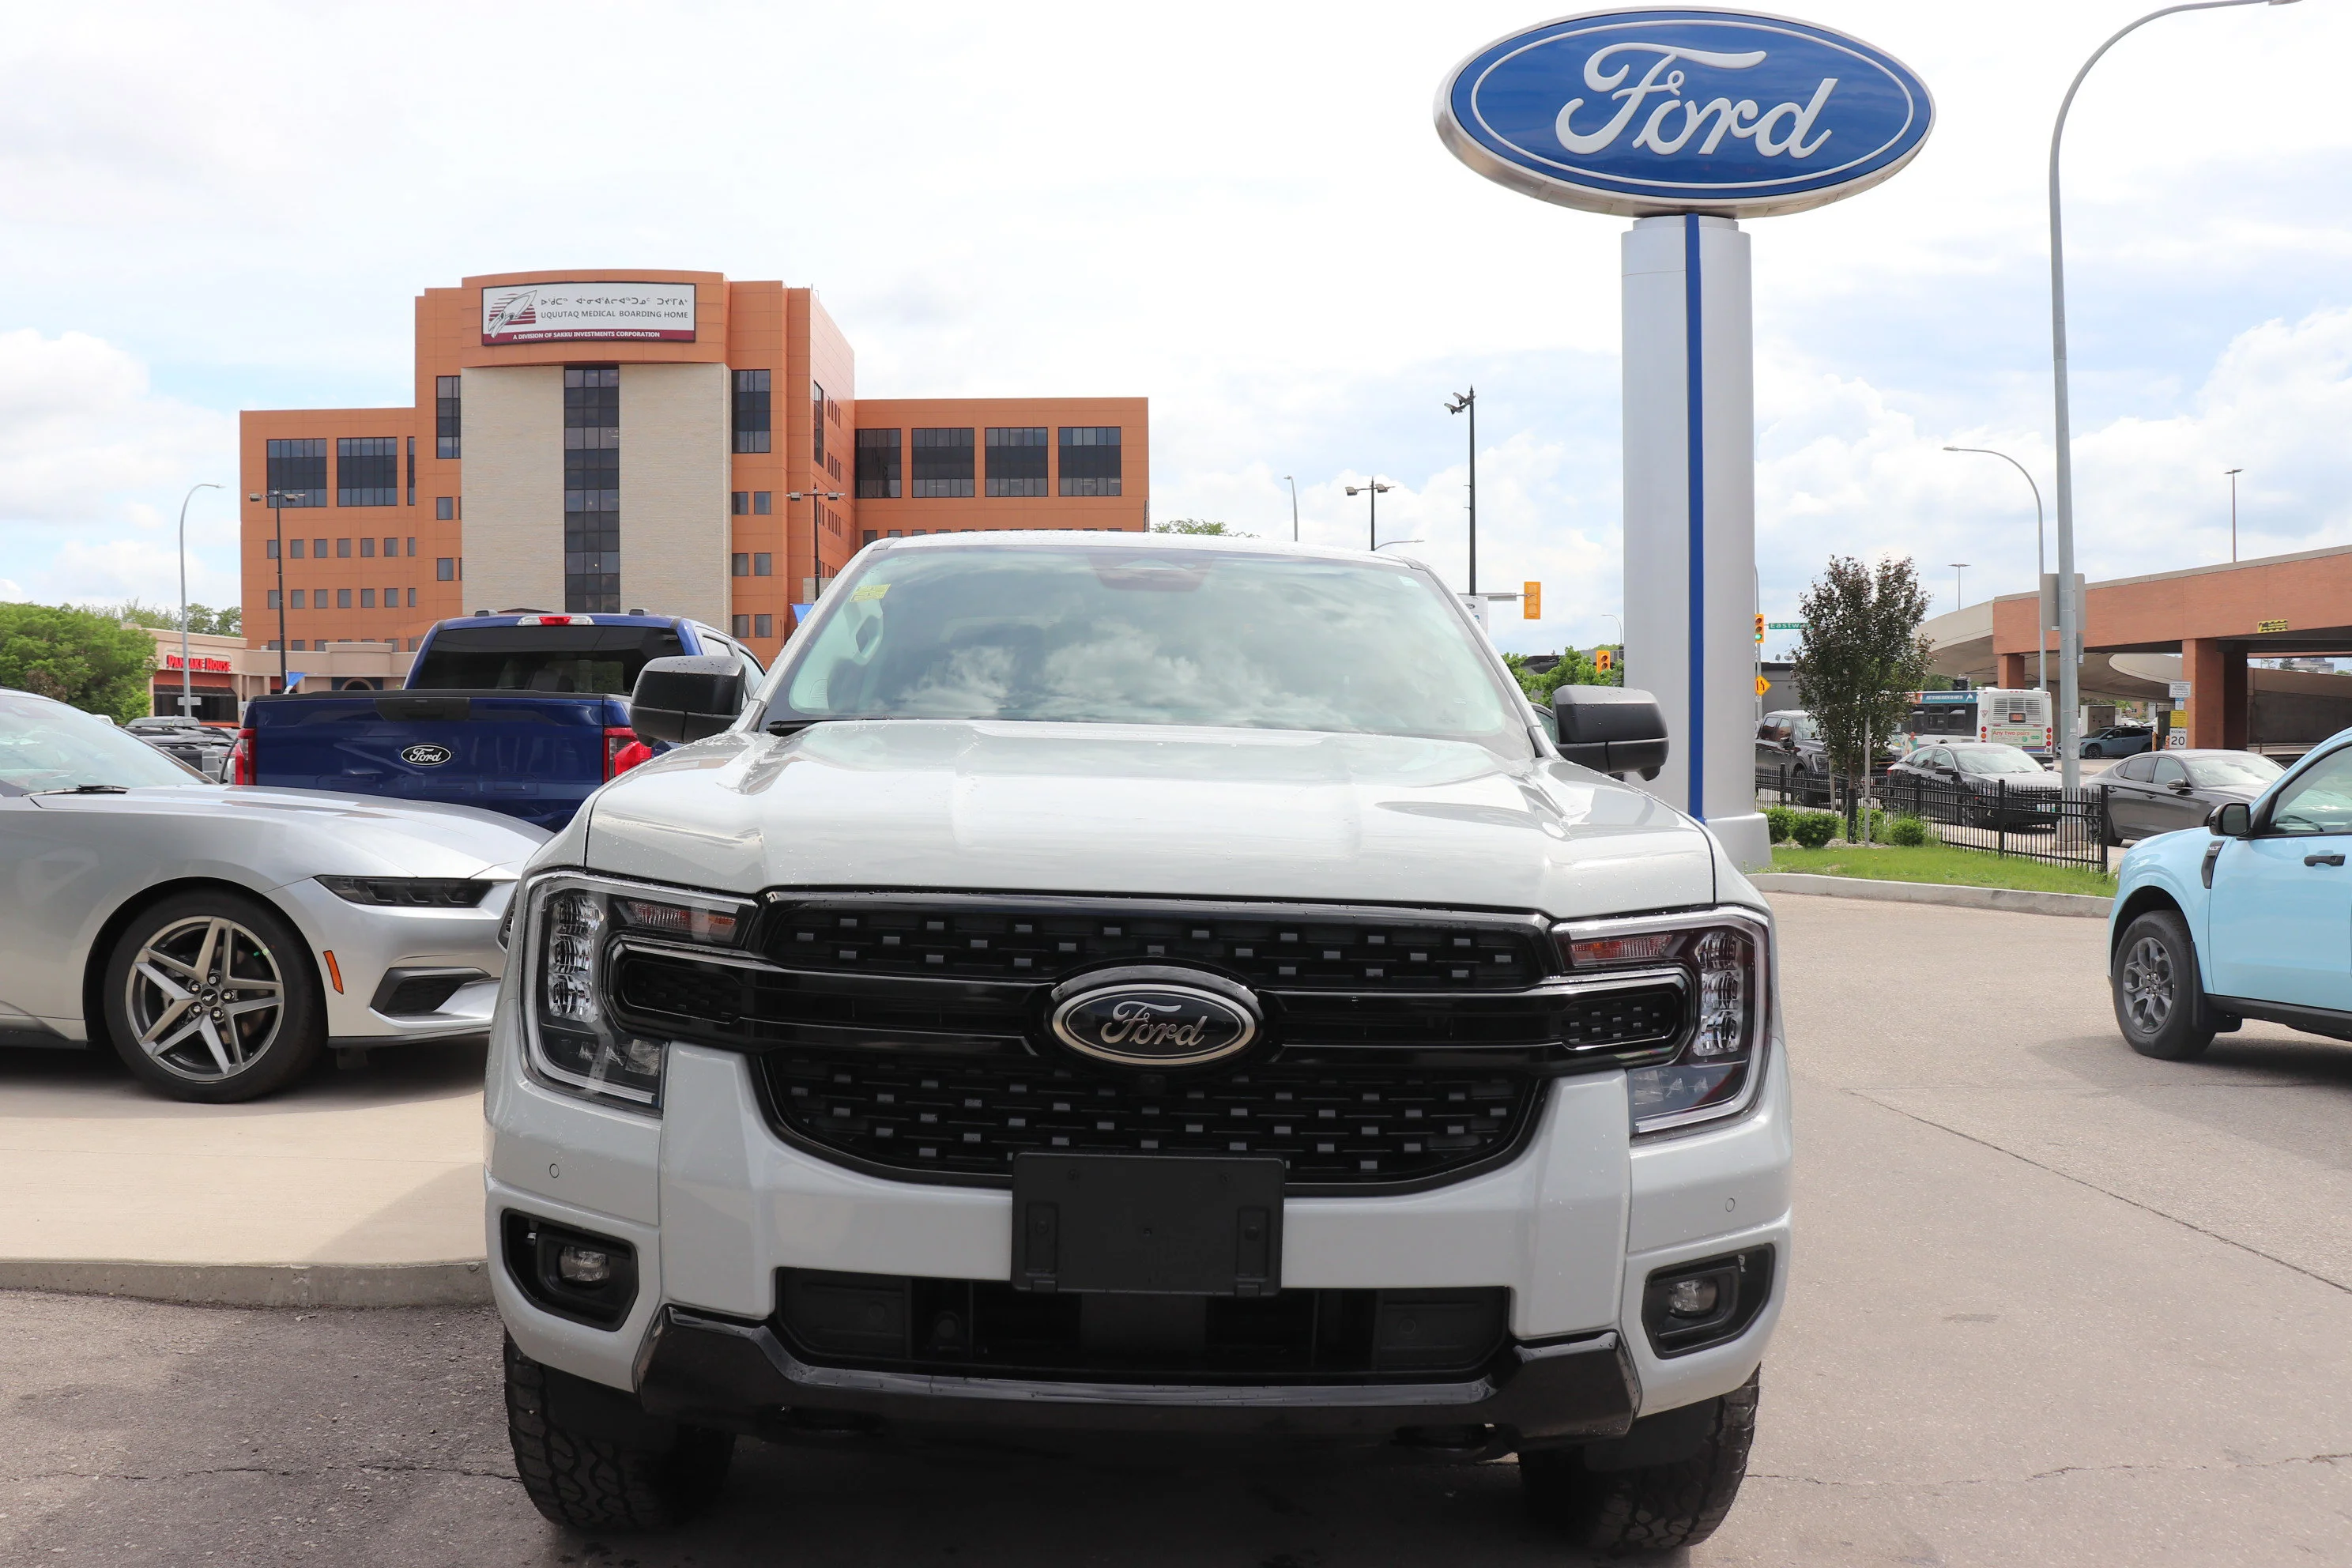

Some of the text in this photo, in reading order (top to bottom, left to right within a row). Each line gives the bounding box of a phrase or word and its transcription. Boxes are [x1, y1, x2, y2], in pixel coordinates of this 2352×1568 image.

[1555, 42, 1838, 158] Ford
[541, 311, 579, 319] UQUUTAQ
[167, 654, 232, 672] PANAKE HOUSE
[2171, 736, 2185, 745] 20
[409, 747, 442, 762] Ford
[1100, 1001, 1208, 1046] Ford
